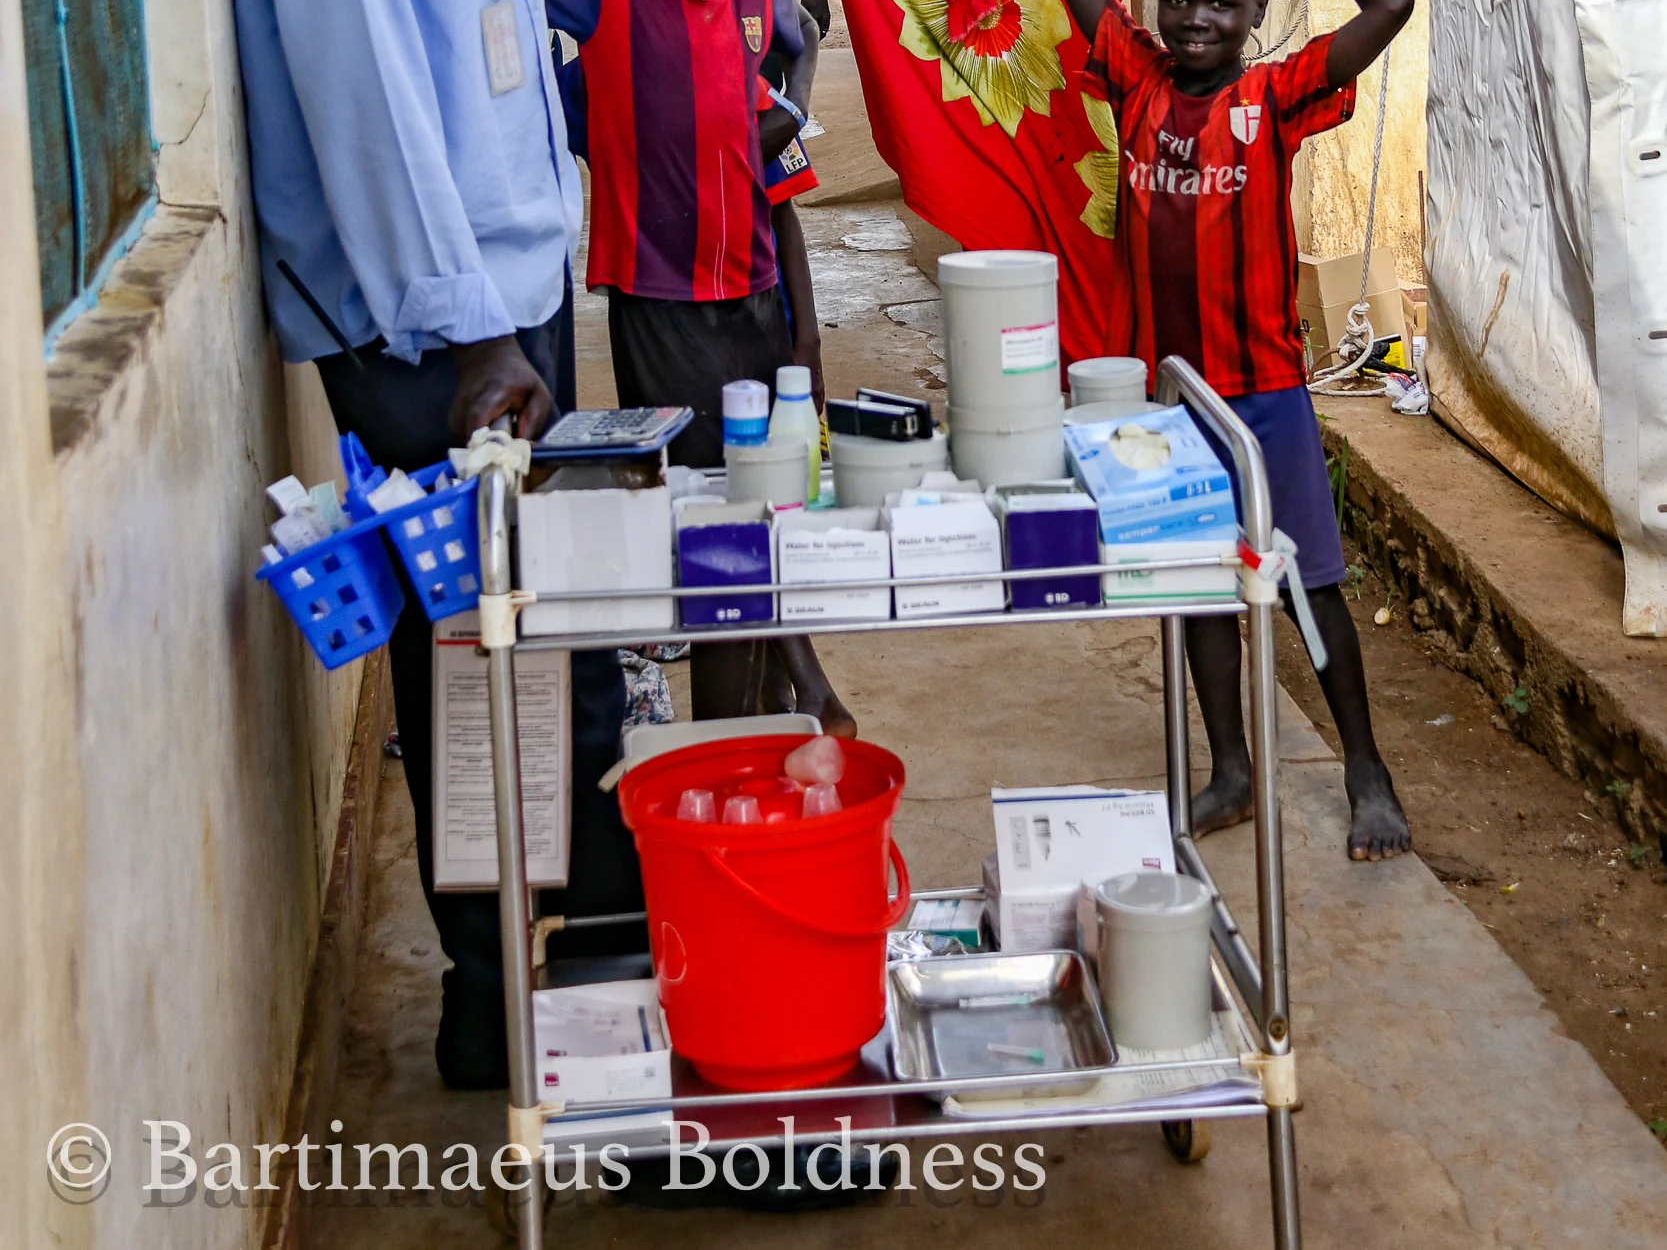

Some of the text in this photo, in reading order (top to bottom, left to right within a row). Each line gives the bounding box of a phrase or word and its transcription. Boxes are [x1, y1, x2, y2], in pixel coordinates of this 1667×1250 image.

[1158, 130, 1194, 161] Fly
[785, 157, 805, 173] LFP
[1125, 150, 1248, 195] mirates
[1055, 592, 1071, 604] BD
[726, 608, 742, 620] BD
